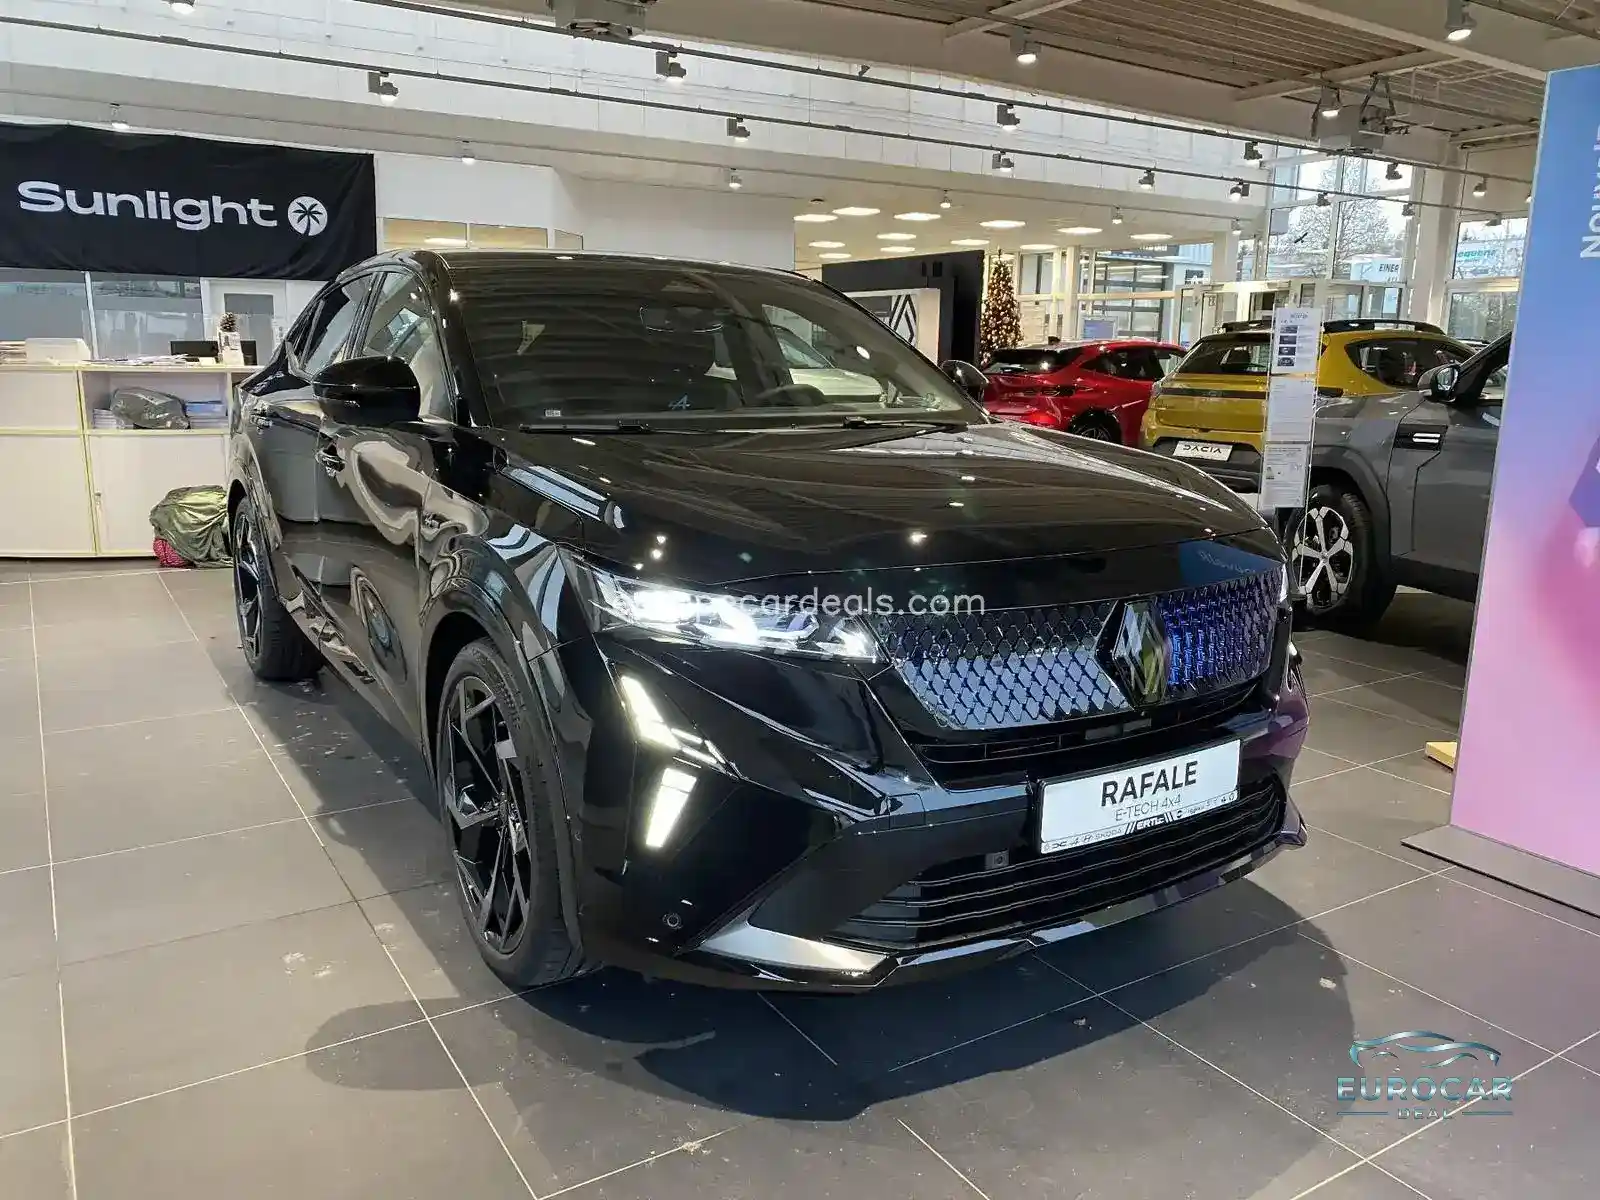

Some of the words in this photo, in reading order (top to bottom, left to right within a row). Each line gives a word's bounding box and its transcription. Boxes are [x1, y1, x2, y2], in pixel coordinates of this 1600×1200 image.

[17, 180, 278, 231] Sunlight
[1182, 444, 1222, 454] DACIA
[1101, 760, 1198, 807] RAFALE
[1115, 800, 1159, 821] E-TECH
